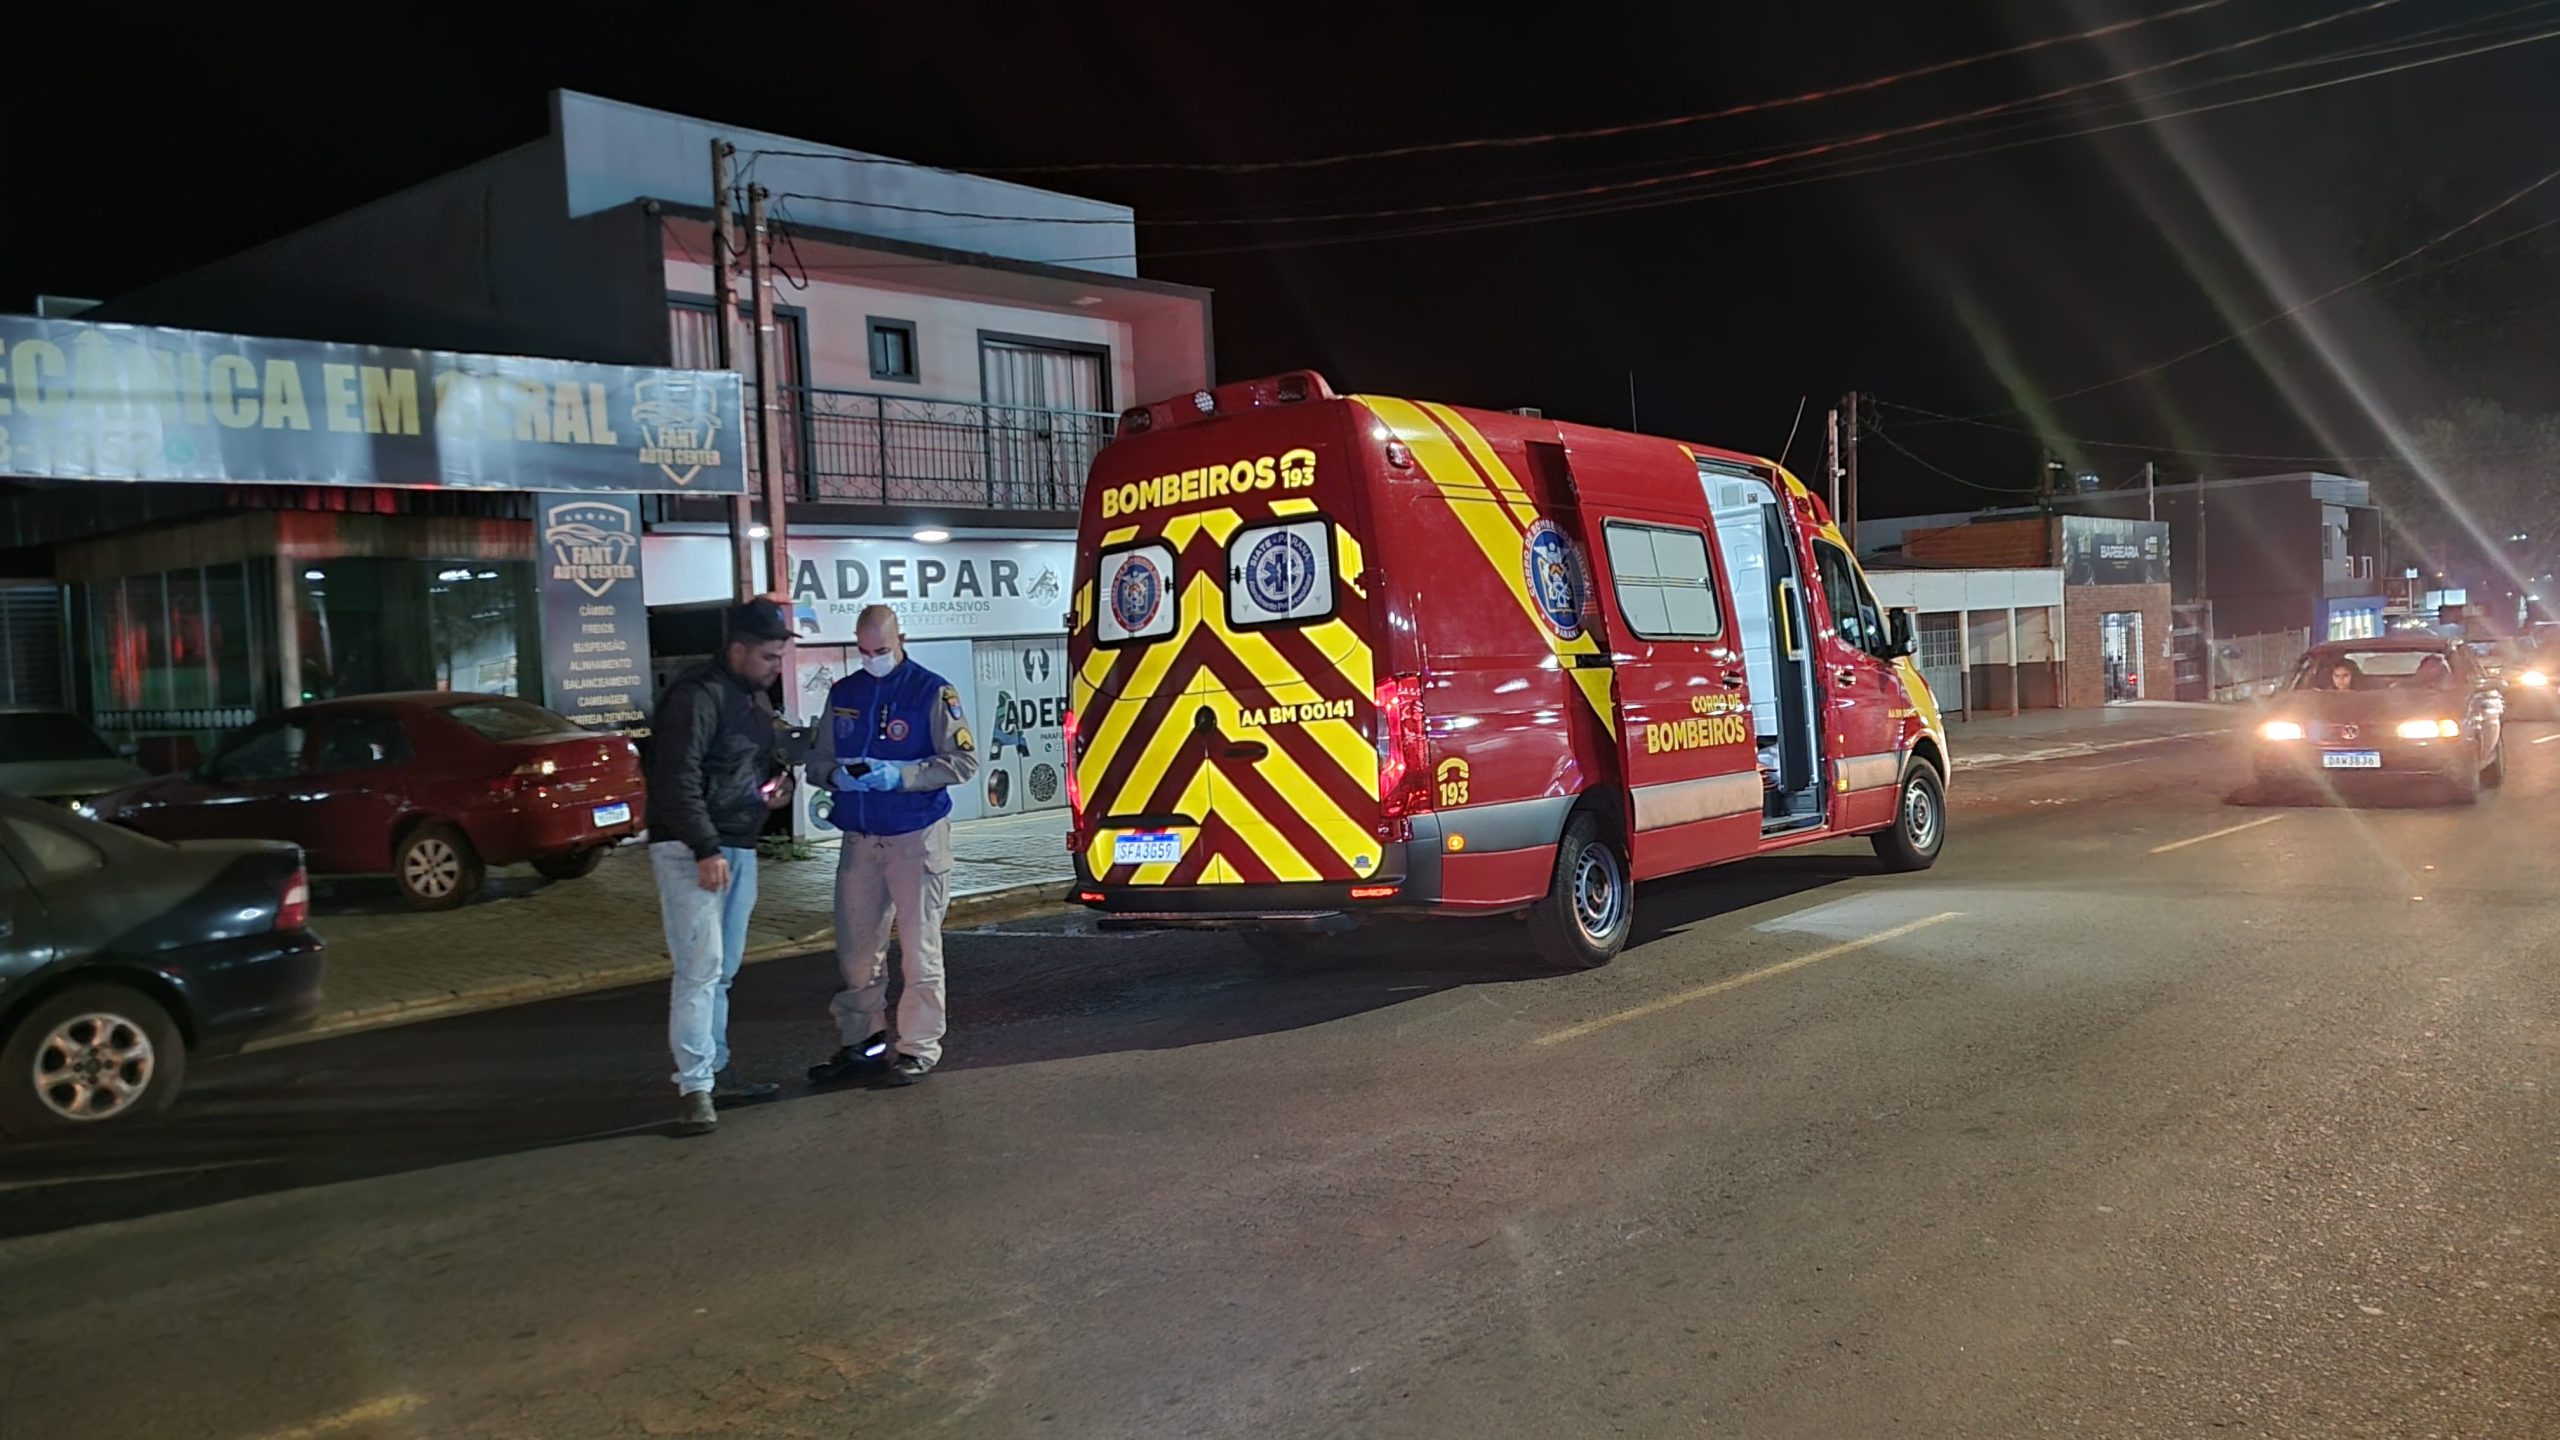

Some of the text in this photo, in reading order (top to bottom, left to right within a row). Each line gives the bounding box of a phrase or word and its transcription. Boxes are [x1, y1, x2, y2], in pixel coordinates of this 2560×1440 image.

[323, 363, 421, 436] EM
[658, 427, 698, 449] FANT
[674, 449, 721, 466] CENTER
[1102, 456, 1276, 518] BOMBEIROS
[1282, 467, 1314, 488] 193
[1525, 530, 1535, 546] DE
[571, 545, 613, 565] FANT
[1249, 538, 1272, 568] SIATE
[2100, 545, 2139, 559] BARBEARIA
[553, 564, 635, 580] AUTO CENTER
[793, 559, 1020, 601] ADEPAR
[1523, 551, 1535, 597] CORPO
[829, 601, 991, 615] PARAOS E ABRASIVOS
[569, 658, 633, 671] ALINHAMENTO
[563, 675, 641, 690] BALANCEAMENTO
[1241, 699, 1354, 727] AA BM 00141
[1691, 693, 1743, 714] CORPO DE
[1646, 715, 1746, 754] BOMBEIROS
[1439, 780, 1469, 806] 193
[1119, 842, 1173, 860] SFA3G59
